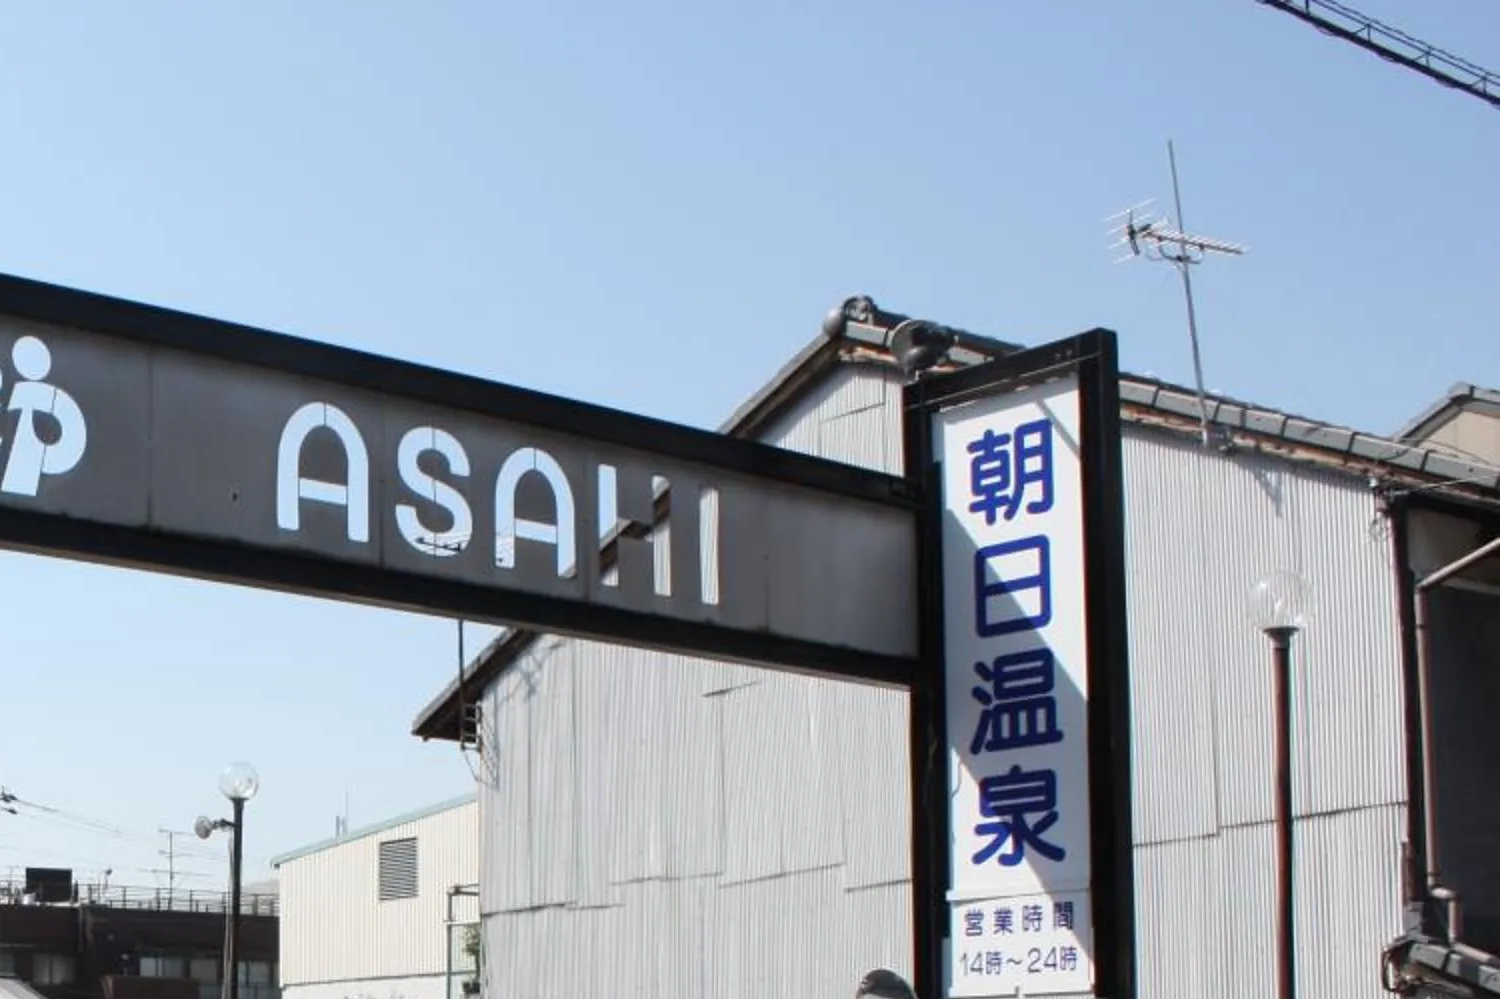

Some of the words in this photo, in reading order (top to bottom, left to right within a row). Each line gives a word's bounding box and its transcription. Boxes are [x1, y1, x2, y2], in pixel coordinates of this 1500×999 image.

[276, 401, 720, 606] ASAHI
[967, 418, 1066, 868] 朝日温泉
[964, 901, 1074, 937] 営業時間
